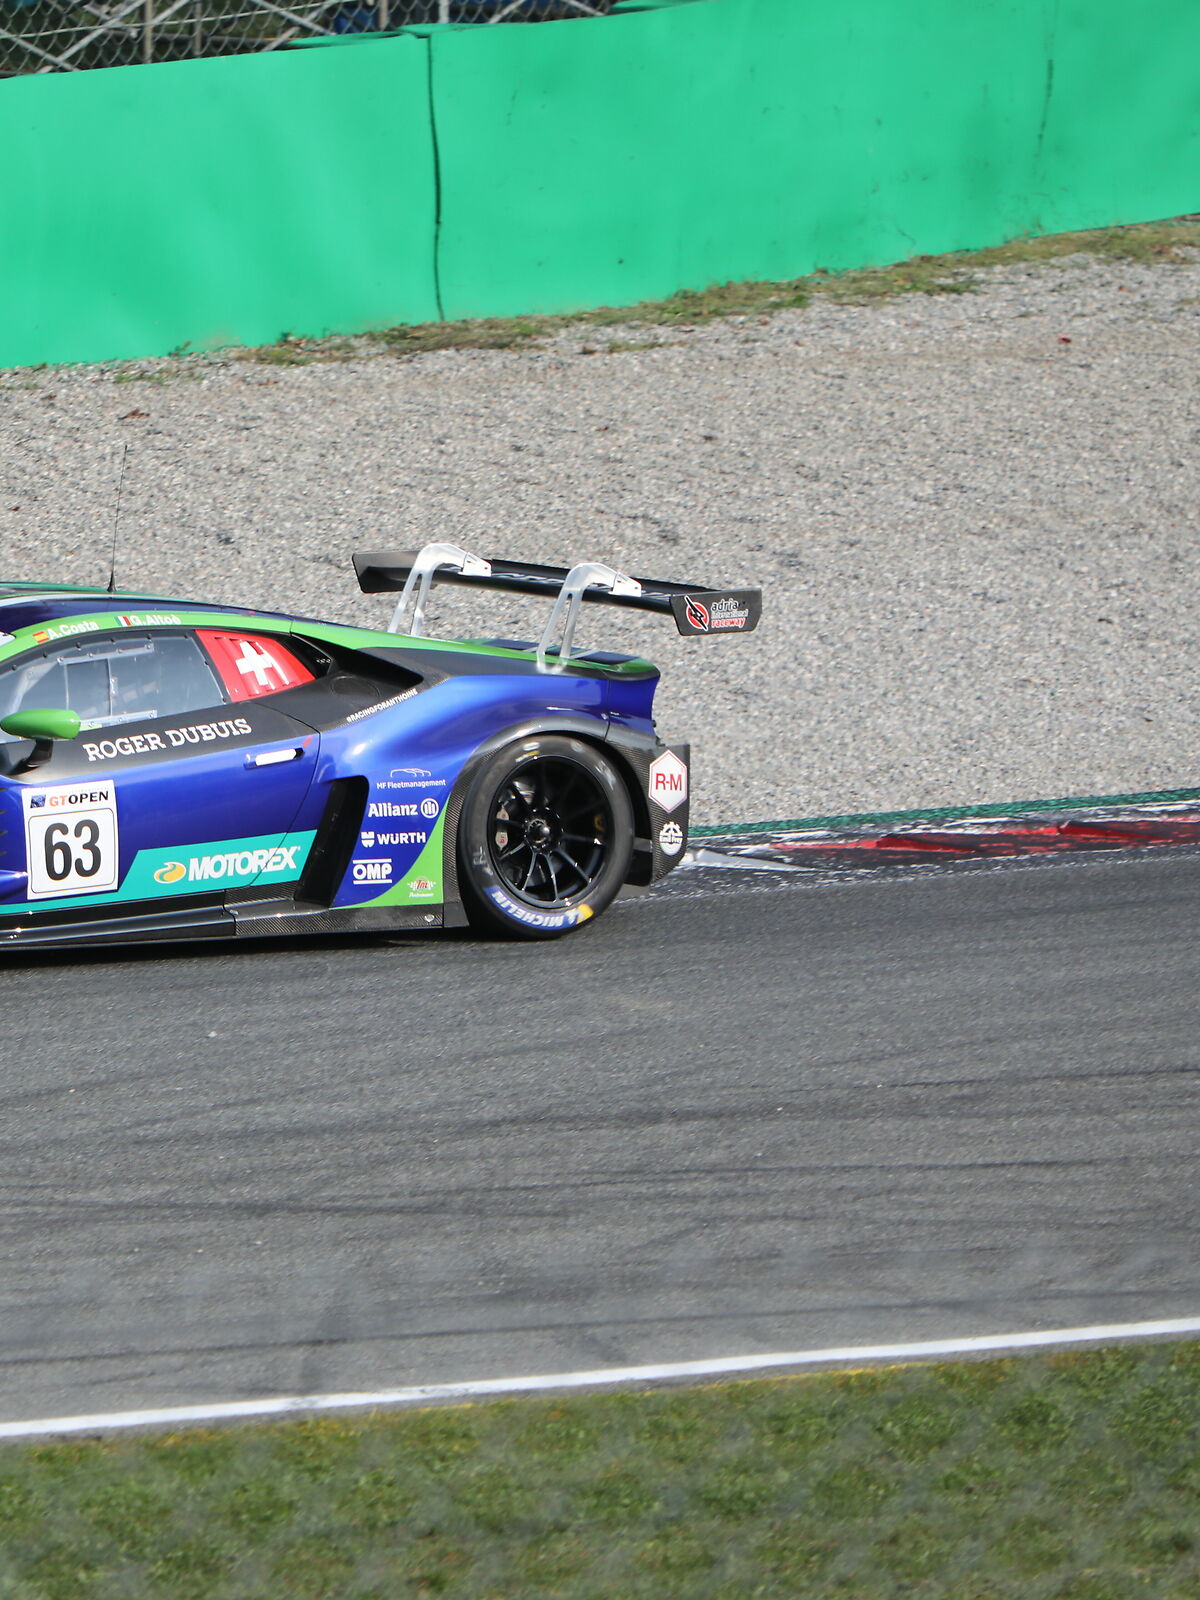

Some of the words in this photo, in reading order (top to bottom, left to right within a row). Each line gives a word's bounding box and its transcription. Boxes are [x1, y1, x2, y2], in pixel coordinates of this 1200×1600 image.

[711, 598, 739, 611] adria
[47, 621, 100, 640] A.Costa
[711, 617, 746, 628] raceway
[82, 733, 166, 762] ROGER
[170, 718, 252, 746] DUBUIS
[387, 779, 446, 790] Fleetmanagement
[655, 773, 683, 791] R-M
[368, 802, 418, 818] Allianz
[43, 819, 100, 881] 63
[188, 846, 298, 881] MOTOREX
[352, 863, 392, 880] OMP
[492, 890, 564, 927] MICHELIN
